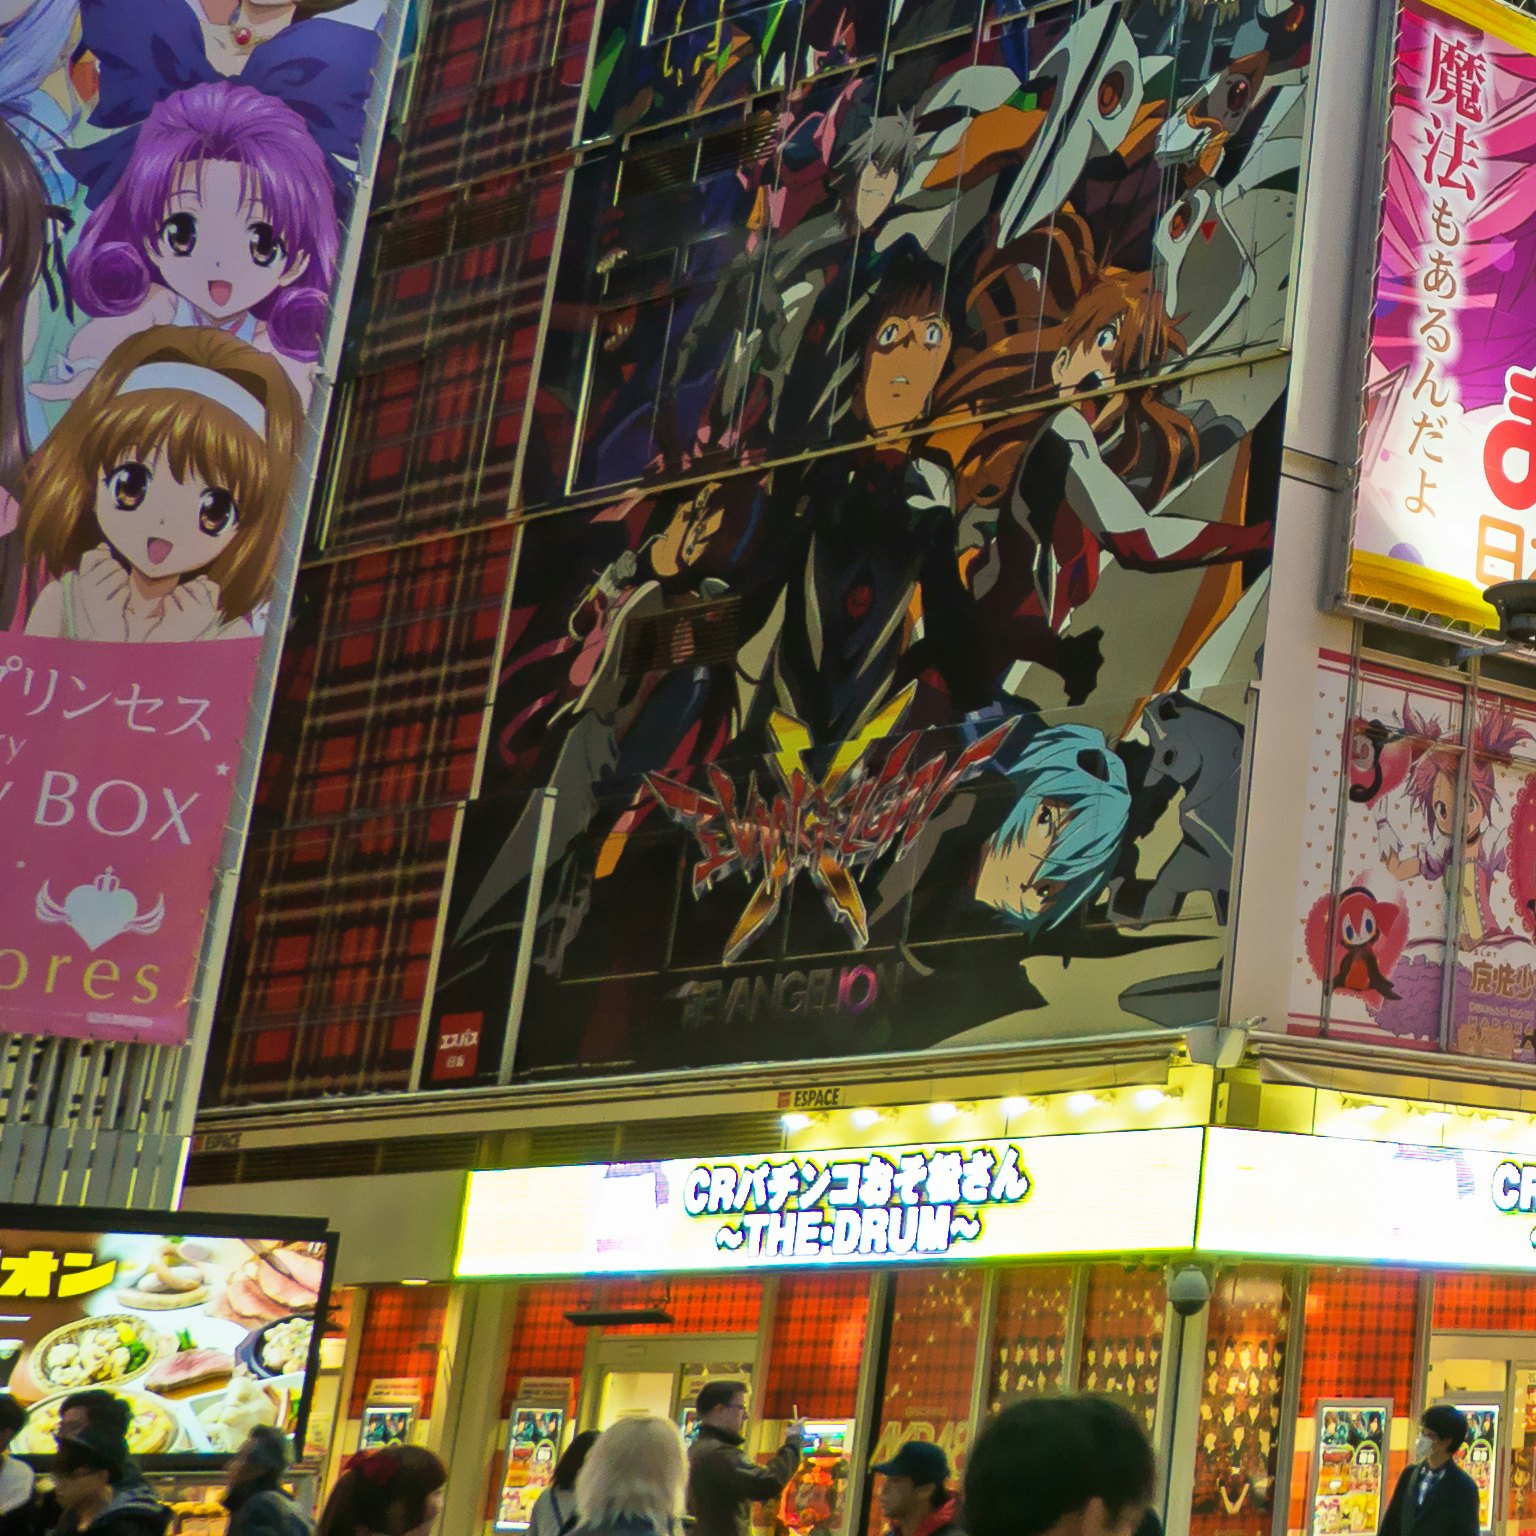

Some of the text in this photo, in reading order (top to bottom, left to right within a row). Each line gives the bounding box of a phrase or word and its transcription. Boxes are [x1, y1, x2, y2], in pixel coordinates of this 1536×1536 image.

[1404, 26, 1492, 520] 魔法もあるんだよ
[34, 769, 202, 846] BOX
[440, 1028, 480, 1049] エスパス
[794, 1088, 841, 1108] ESPACE
